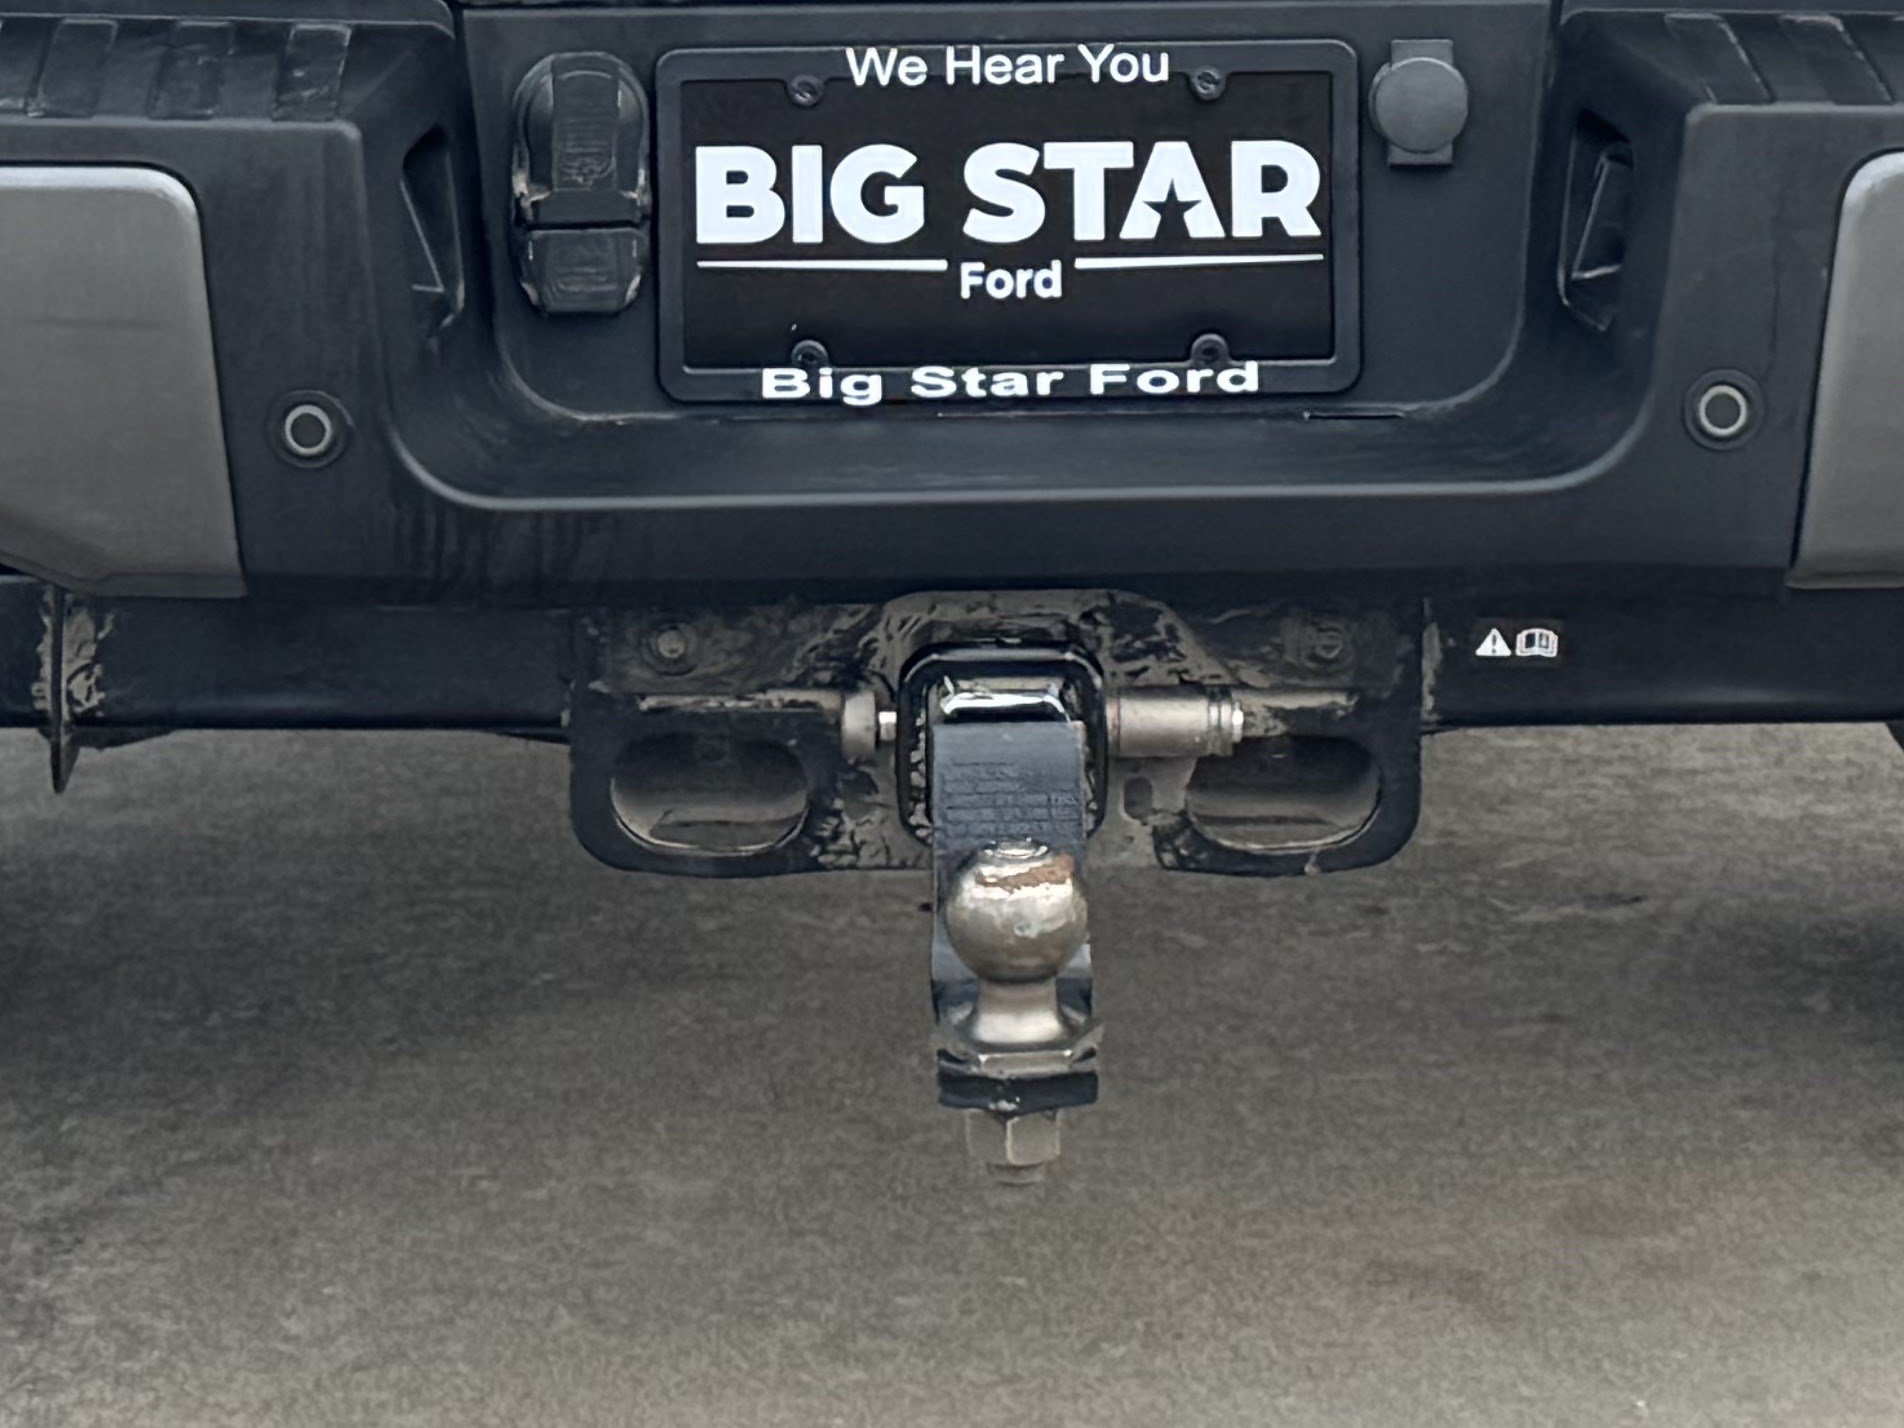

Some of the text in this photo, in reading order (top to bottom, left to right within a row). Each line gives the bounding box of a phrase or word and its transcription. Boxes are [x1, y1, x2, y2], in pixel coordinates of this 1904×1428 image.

[845, 42, 1170, 87] We Hear You
[695, 140, 1322, 244] BIG STAR
[959, 259, 1063, 300] Ford
[761, 360, 1260, 406] Big Star Ford
